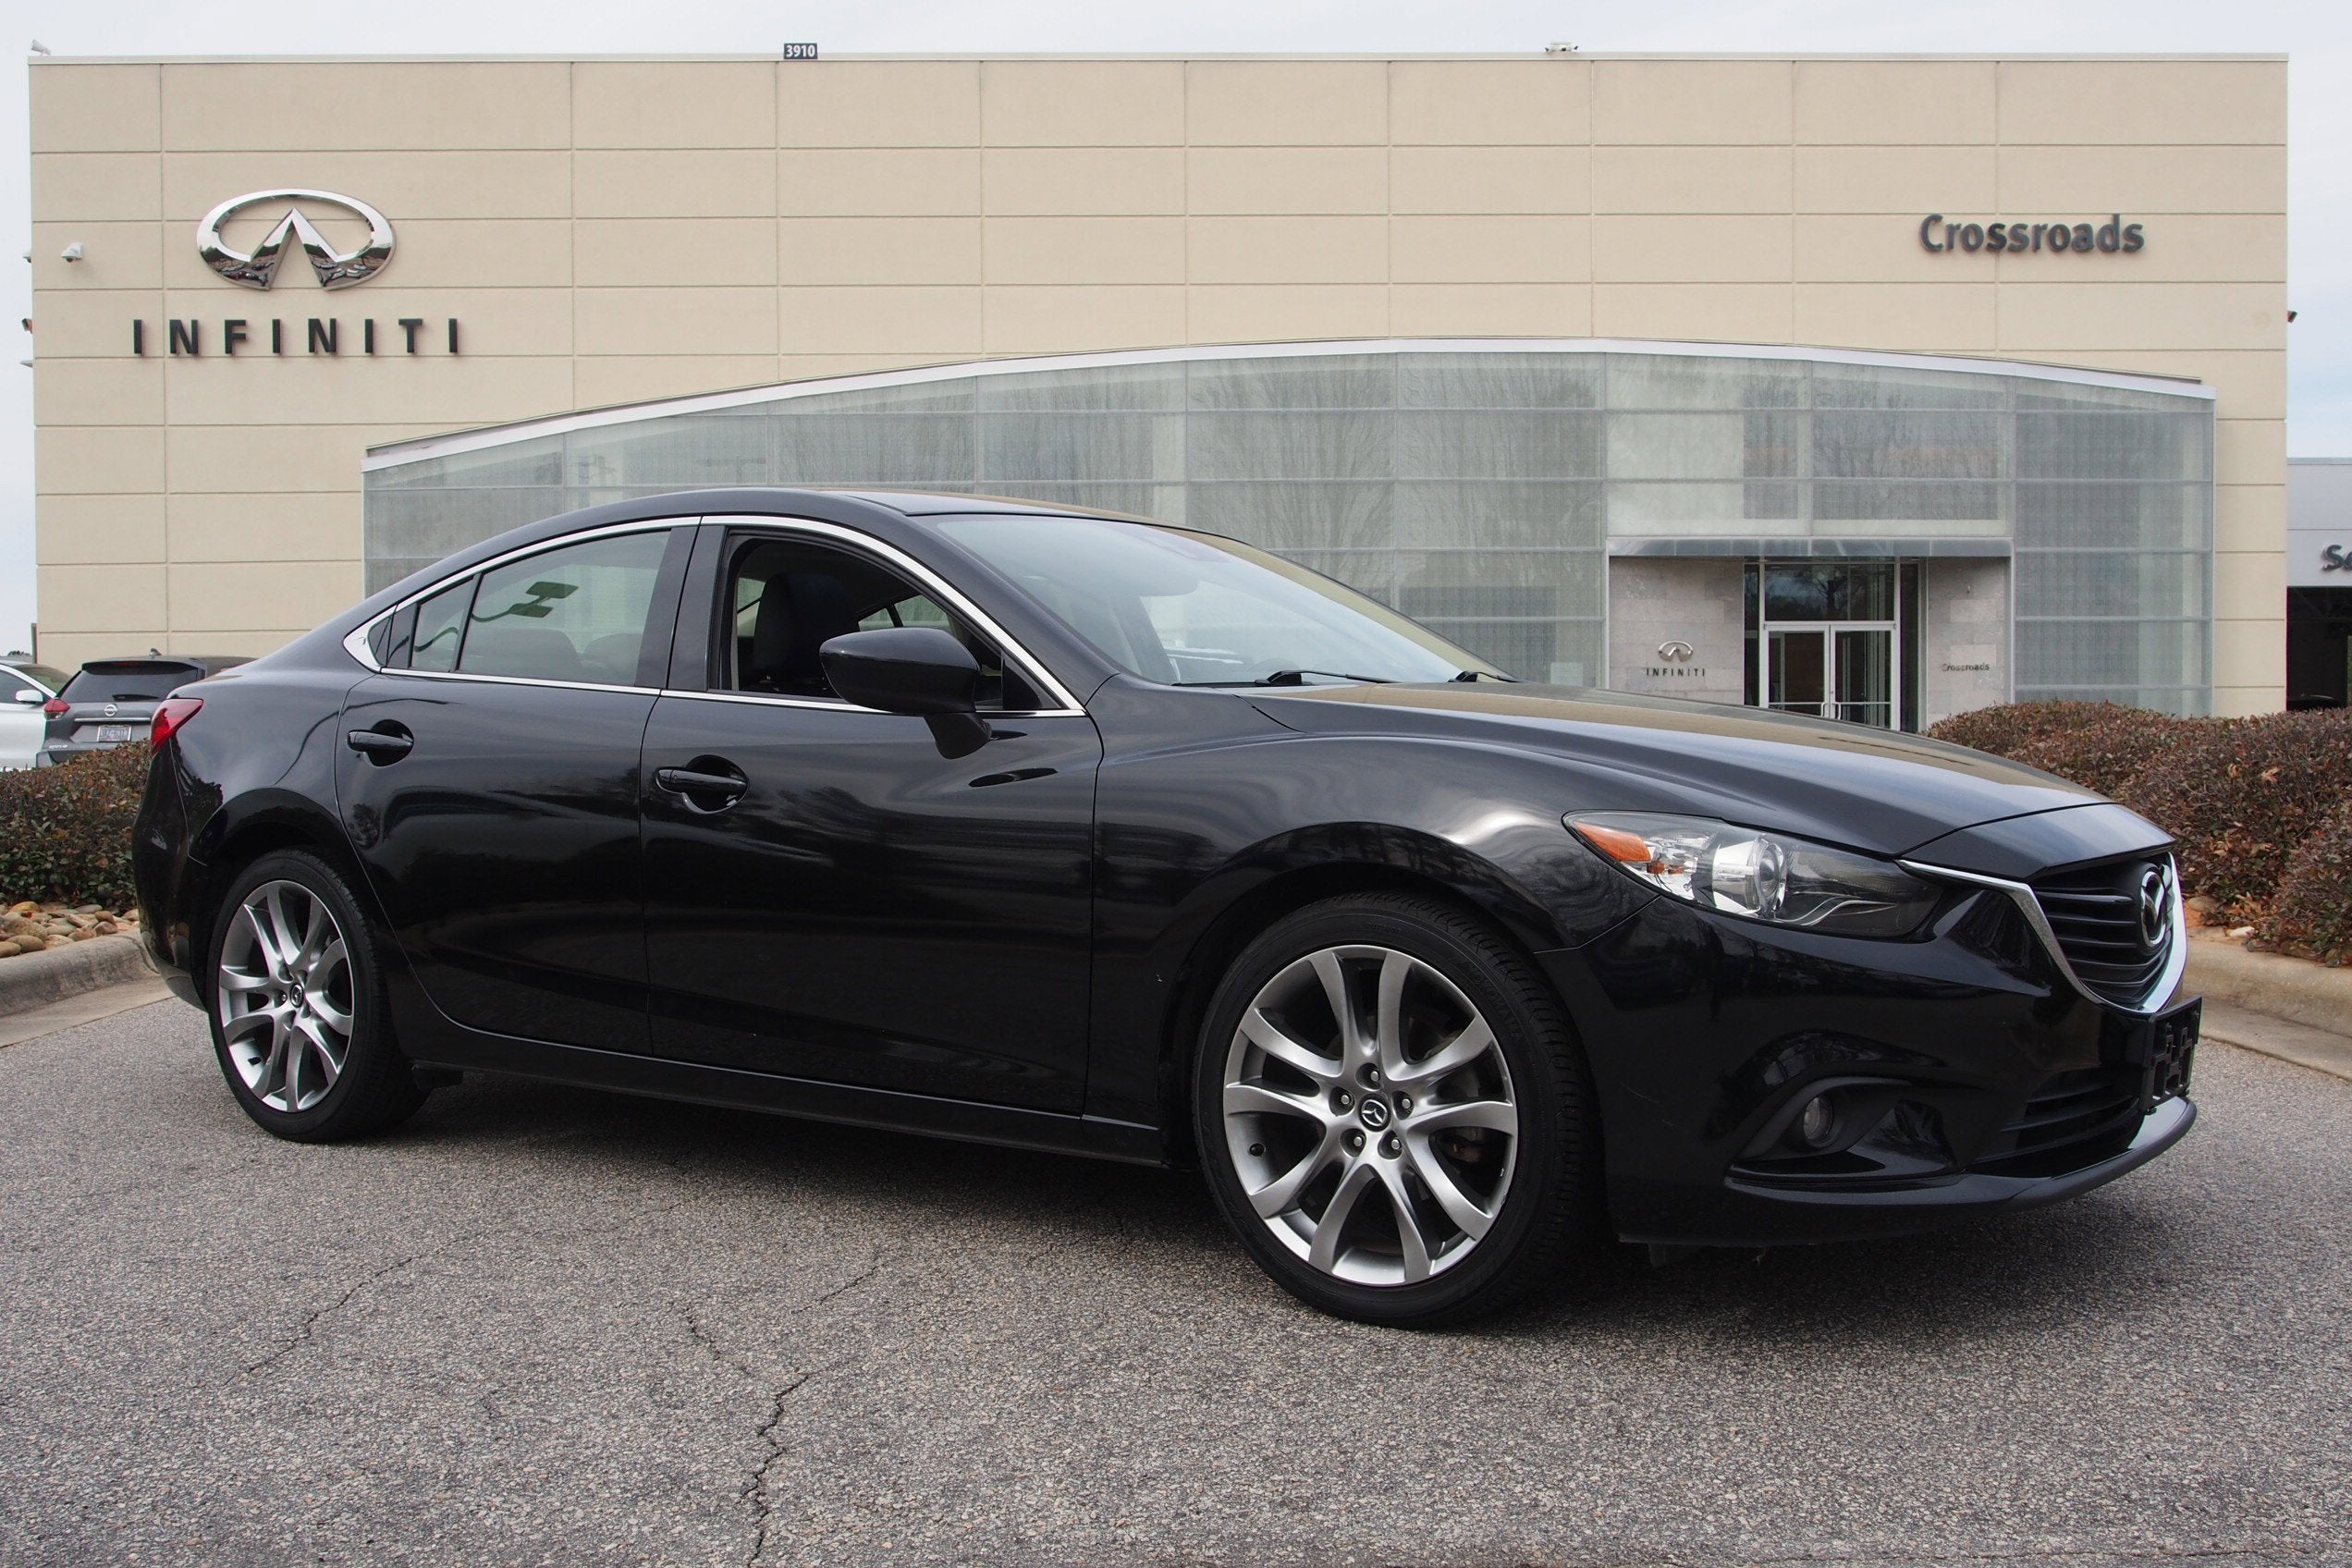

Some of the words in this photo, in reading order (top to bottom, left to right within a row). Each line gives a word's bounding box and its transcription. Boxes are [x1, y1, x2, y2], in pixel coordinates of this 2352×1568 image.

[786, 44, 815, 57] 3910
[1920, 213, 2145, 252] Crossroads
[133, 318, 459, 355] INFINITI
[1646, 668, 1705, 677] INFINITI
[1942, 662, 1990, 671] Crossroads
